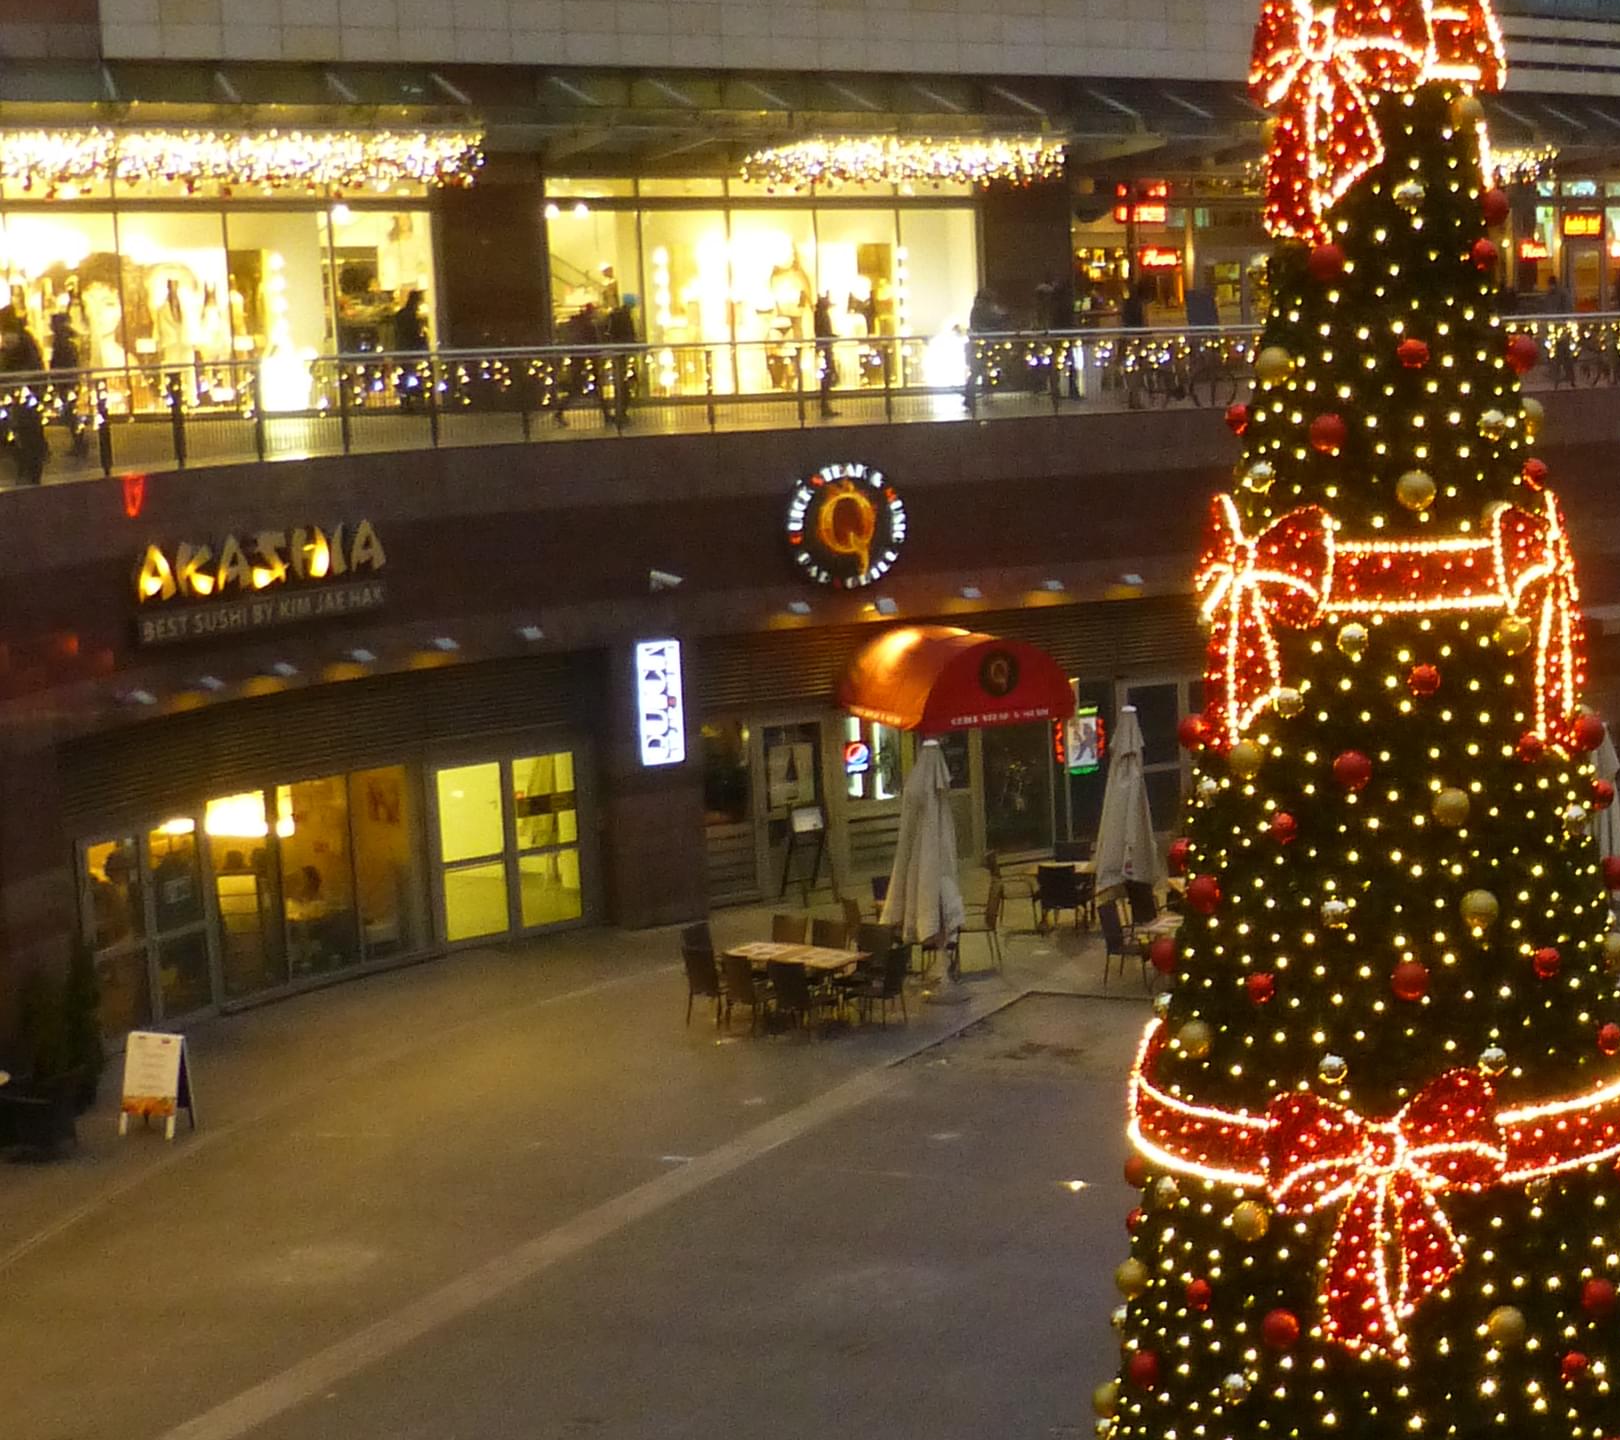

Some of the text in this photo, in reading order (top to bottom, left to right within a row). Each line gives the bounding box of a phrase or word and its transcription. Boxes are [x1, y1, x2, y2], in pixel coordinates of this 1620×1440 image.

[139, 519, 387, 603] AKASHIA
[143, 617, 188, 643] BEST
[193, 608, 248, 634] SUSHI
[252, 603, 274, 626] BY
[279, 595, 312, 617] KIM
